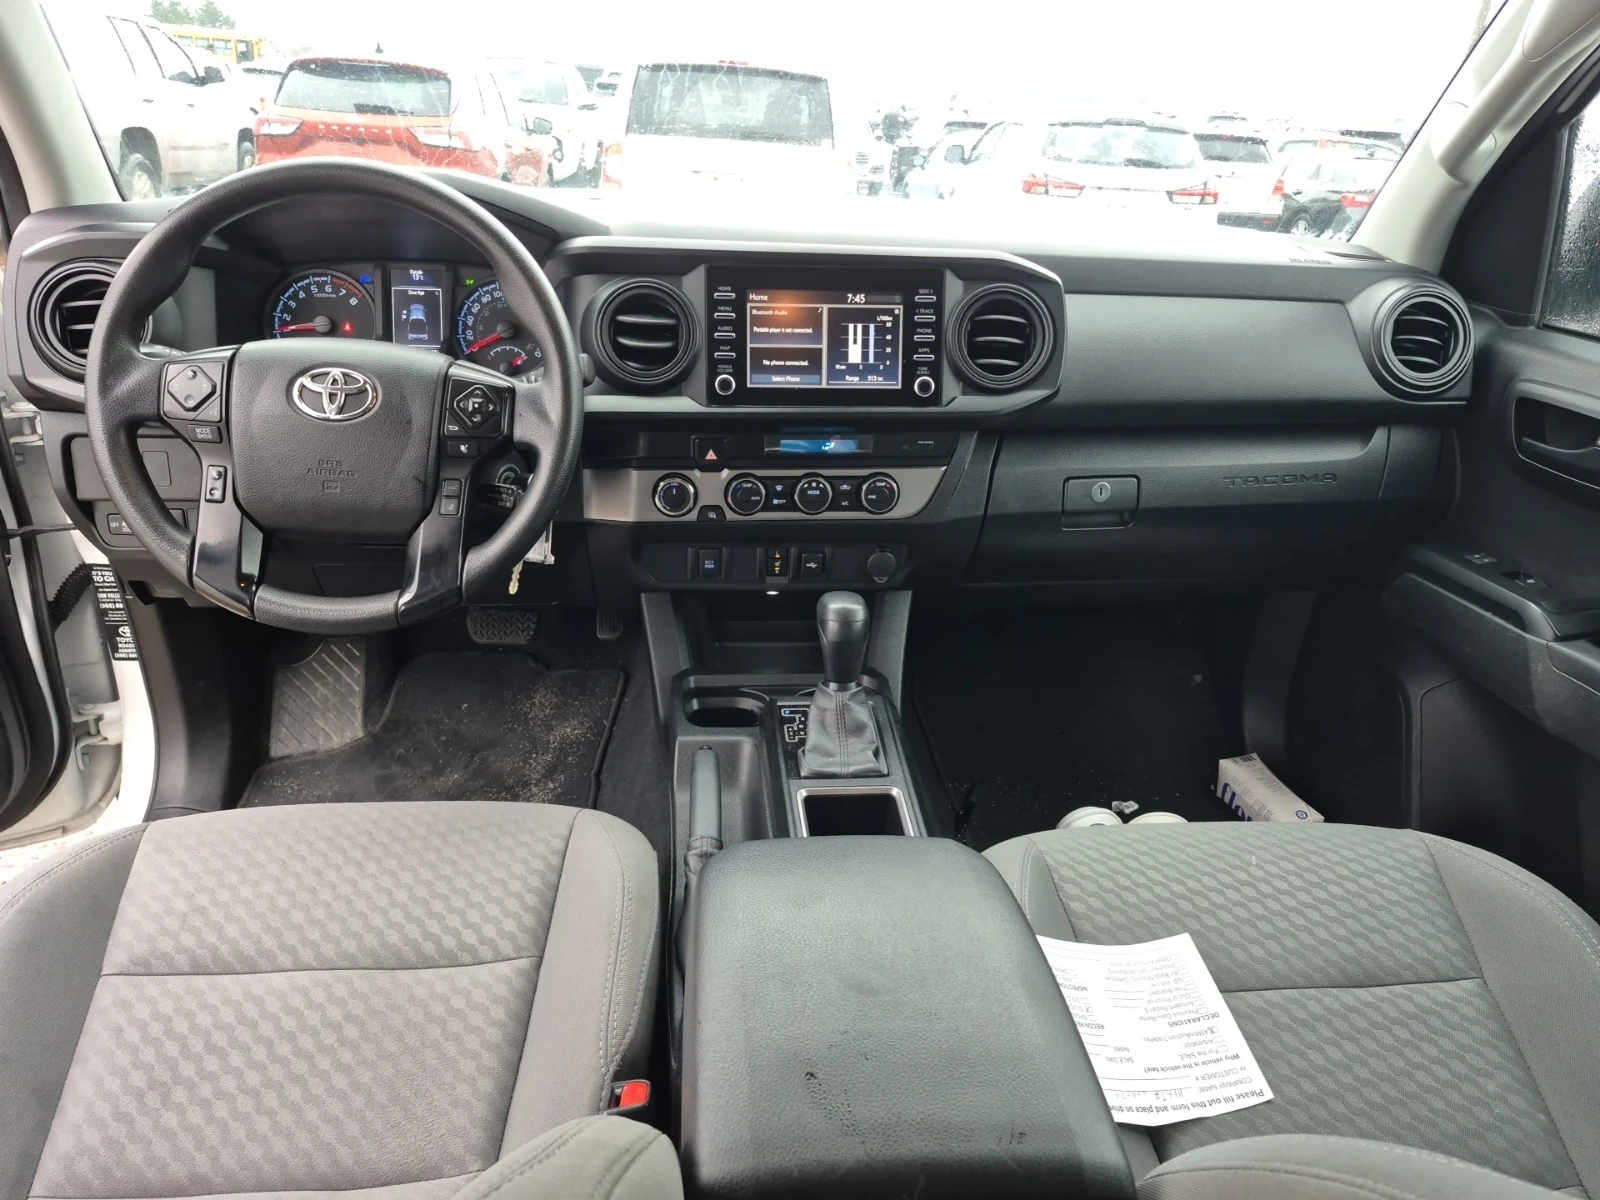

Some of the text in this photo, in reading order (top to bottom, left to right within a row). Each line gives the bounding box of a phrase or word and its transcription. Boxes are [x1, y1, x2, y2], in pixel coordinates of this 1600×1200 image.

[310, 285, 318, 293] 5
[325, 284, 332, 293] 6
[338, 288, 347, 296] 7
[298, 291, 306, 299] 4
[481, 294, 491, 304] 80
[749, 293, 768, 301] Home
[847, 294, 866, 303] 7:45
[288, 300, 297, 309] 3
[349, 297, 358, 306] 8
[471, 303, 481, 314] 60
[466, 315, 474, 327] 40
[466, 330, 474, 341] 20
[302, 468, 356, 477] AIRBAG
[1222, 472, 1338, 487] TACOMA
[1221, 783, 1252, 821] flo
[1173, 977, 1183, 985] US
[1148, 988, 1174, 996] Branded
[1169, 1002, 1194, 1010] Accident
[1172, 1009, 1199, 1017] Previous
[1167, 1011, 1220, 1028] DECLARATIONS
[1183, 1039, 1214, 1049] Arbitration
[1118, 1056, 1134, 1064] SALE
[1179, 1052, 1197, 1060] SALE
[1224, 1053, 1240, 1062] Why
[1201, 1056, 1224, 1066] vehicle
[1143, 1066, 1159, 1074] here?
[1159, 1064, 1181, 1073] vehicle
[1182, 1063, 1193, 1071] the
[1201, 1067, 1239, 1080] CUSTOMER
[1197, 1076, 1253, 1093] COMPANY NAME
[1235, 1088, 1264, 1100] Please
[1207, 1097, 1221, 1106] out
[1223, 1095, 1235, 1105] fill
[1135, 1104, 1154, 1115] place
[1170, 1103, 1190, 1112] form
[1191, 1100, 1206, 1110] this
[1155, 1106, 1169, 1114] and
